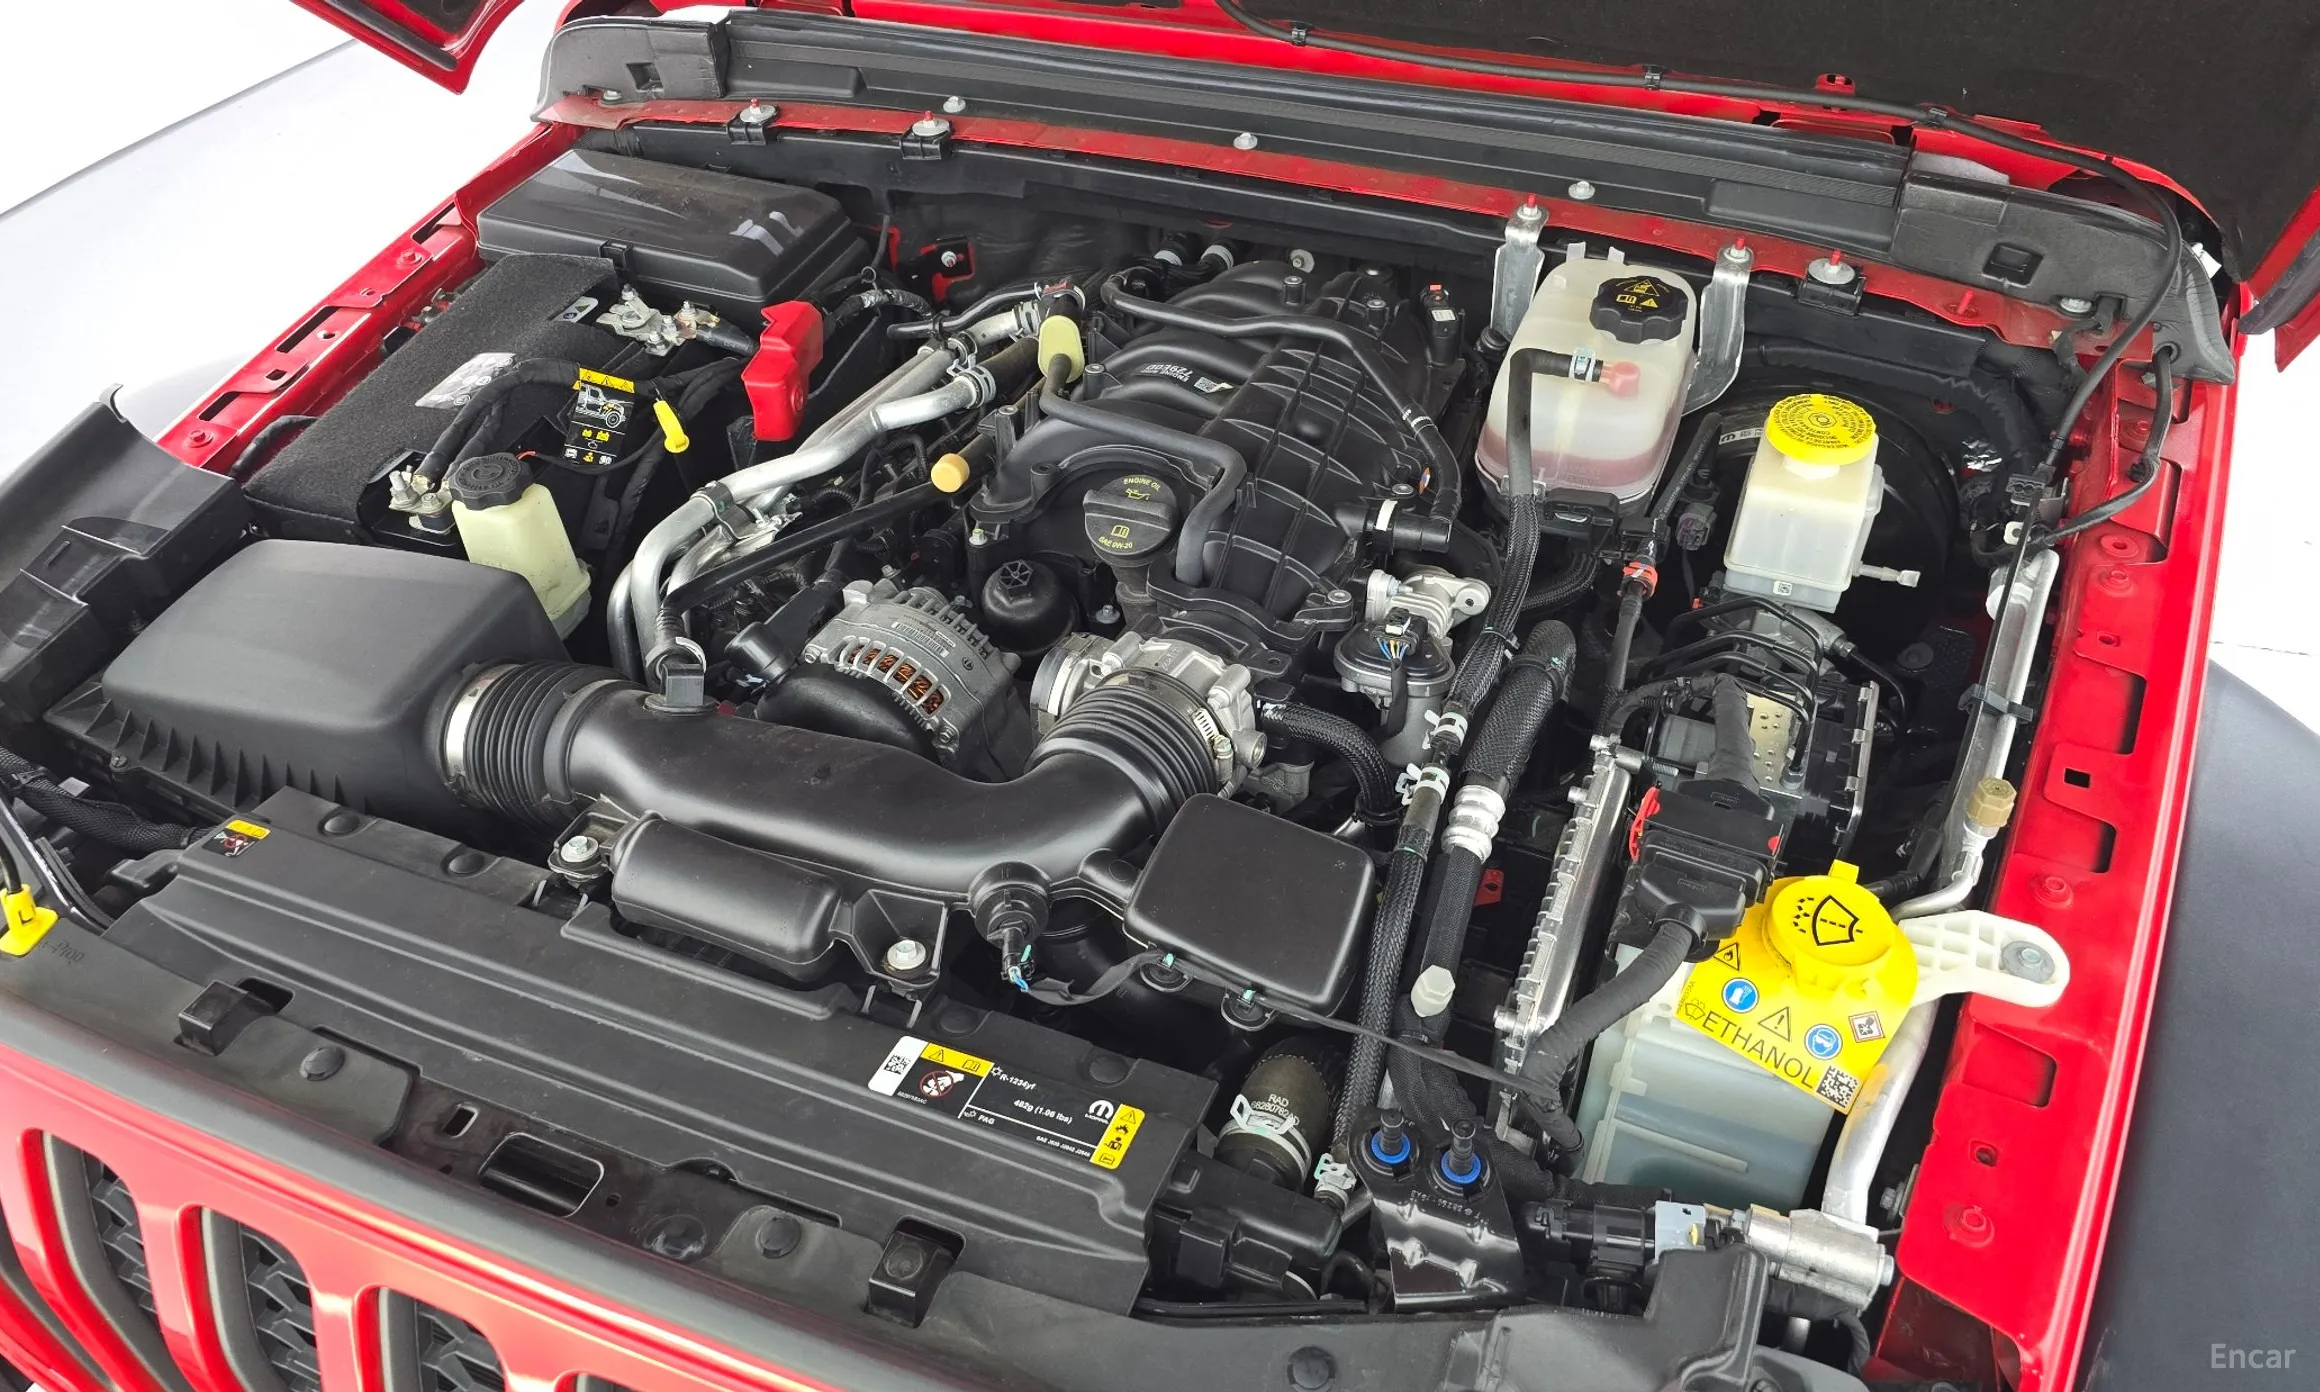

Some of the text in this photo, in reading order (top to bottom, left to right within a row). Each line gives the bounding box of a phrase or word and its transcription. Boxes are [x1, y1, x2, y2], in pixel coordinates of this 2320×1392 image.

[1123, 477, 1161, 492] ENGINE OIL
[1702, 1010, 1813, 1089] ETHANOL
[1000, 1073, 1037, 1090] R-1234yf
[1268, 1093, 1289, 1107] RAD
[978, 1115, 995, 1125] PAG
[1013, 1099, 1034, 1112] 482g
[1056, 1112, 1073, 1125] lbs)
